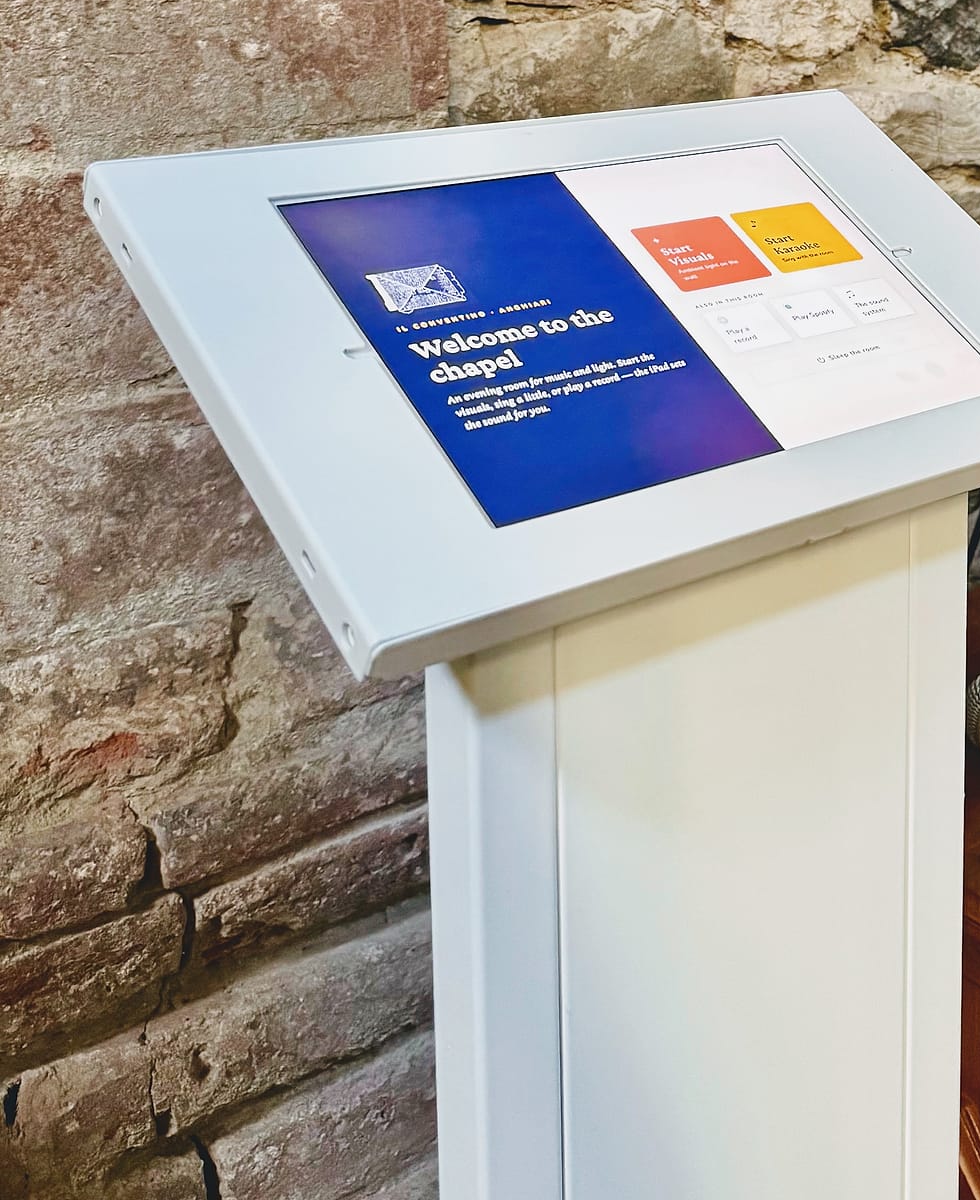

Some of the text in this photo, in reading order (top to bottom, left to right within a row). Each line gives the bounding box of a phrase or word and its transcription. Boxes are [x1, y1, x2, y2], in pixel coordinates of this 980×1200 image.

[660, 244, 694, 257] Start
[764, 235, 795, 245] Start
[773, 241, 821, 255] Karaoke
[668, 251, 715, 267] Visuals
[394, 325, 409, 333] IL
[411, 310, 486, 330] CONVENTINO
[498, 298, 552, 314] ANGHIARI
[407, 308, 615, 360] Welcome to the
[429, 348, 524, 384] chapel
[447, 352, 656, 406] An evening room for music and light. Start the
[454, 402, 494, 418] visuals,
[494, 397, 517, 409] sing
[516, 394, 525, 404] a
[524, 388, 553, 403] little,
[550, 386, 563, 397] or
[562, 381, 585, 396] play
[584, 380, 593, 389] a
[592, 372, 621, 387] record
[633, 367, 650, 378] the
[649, 361, 670, 374] iPad
[670, 359, 688, 369] sets
[463, 403, 552, 431] the sound for you.
